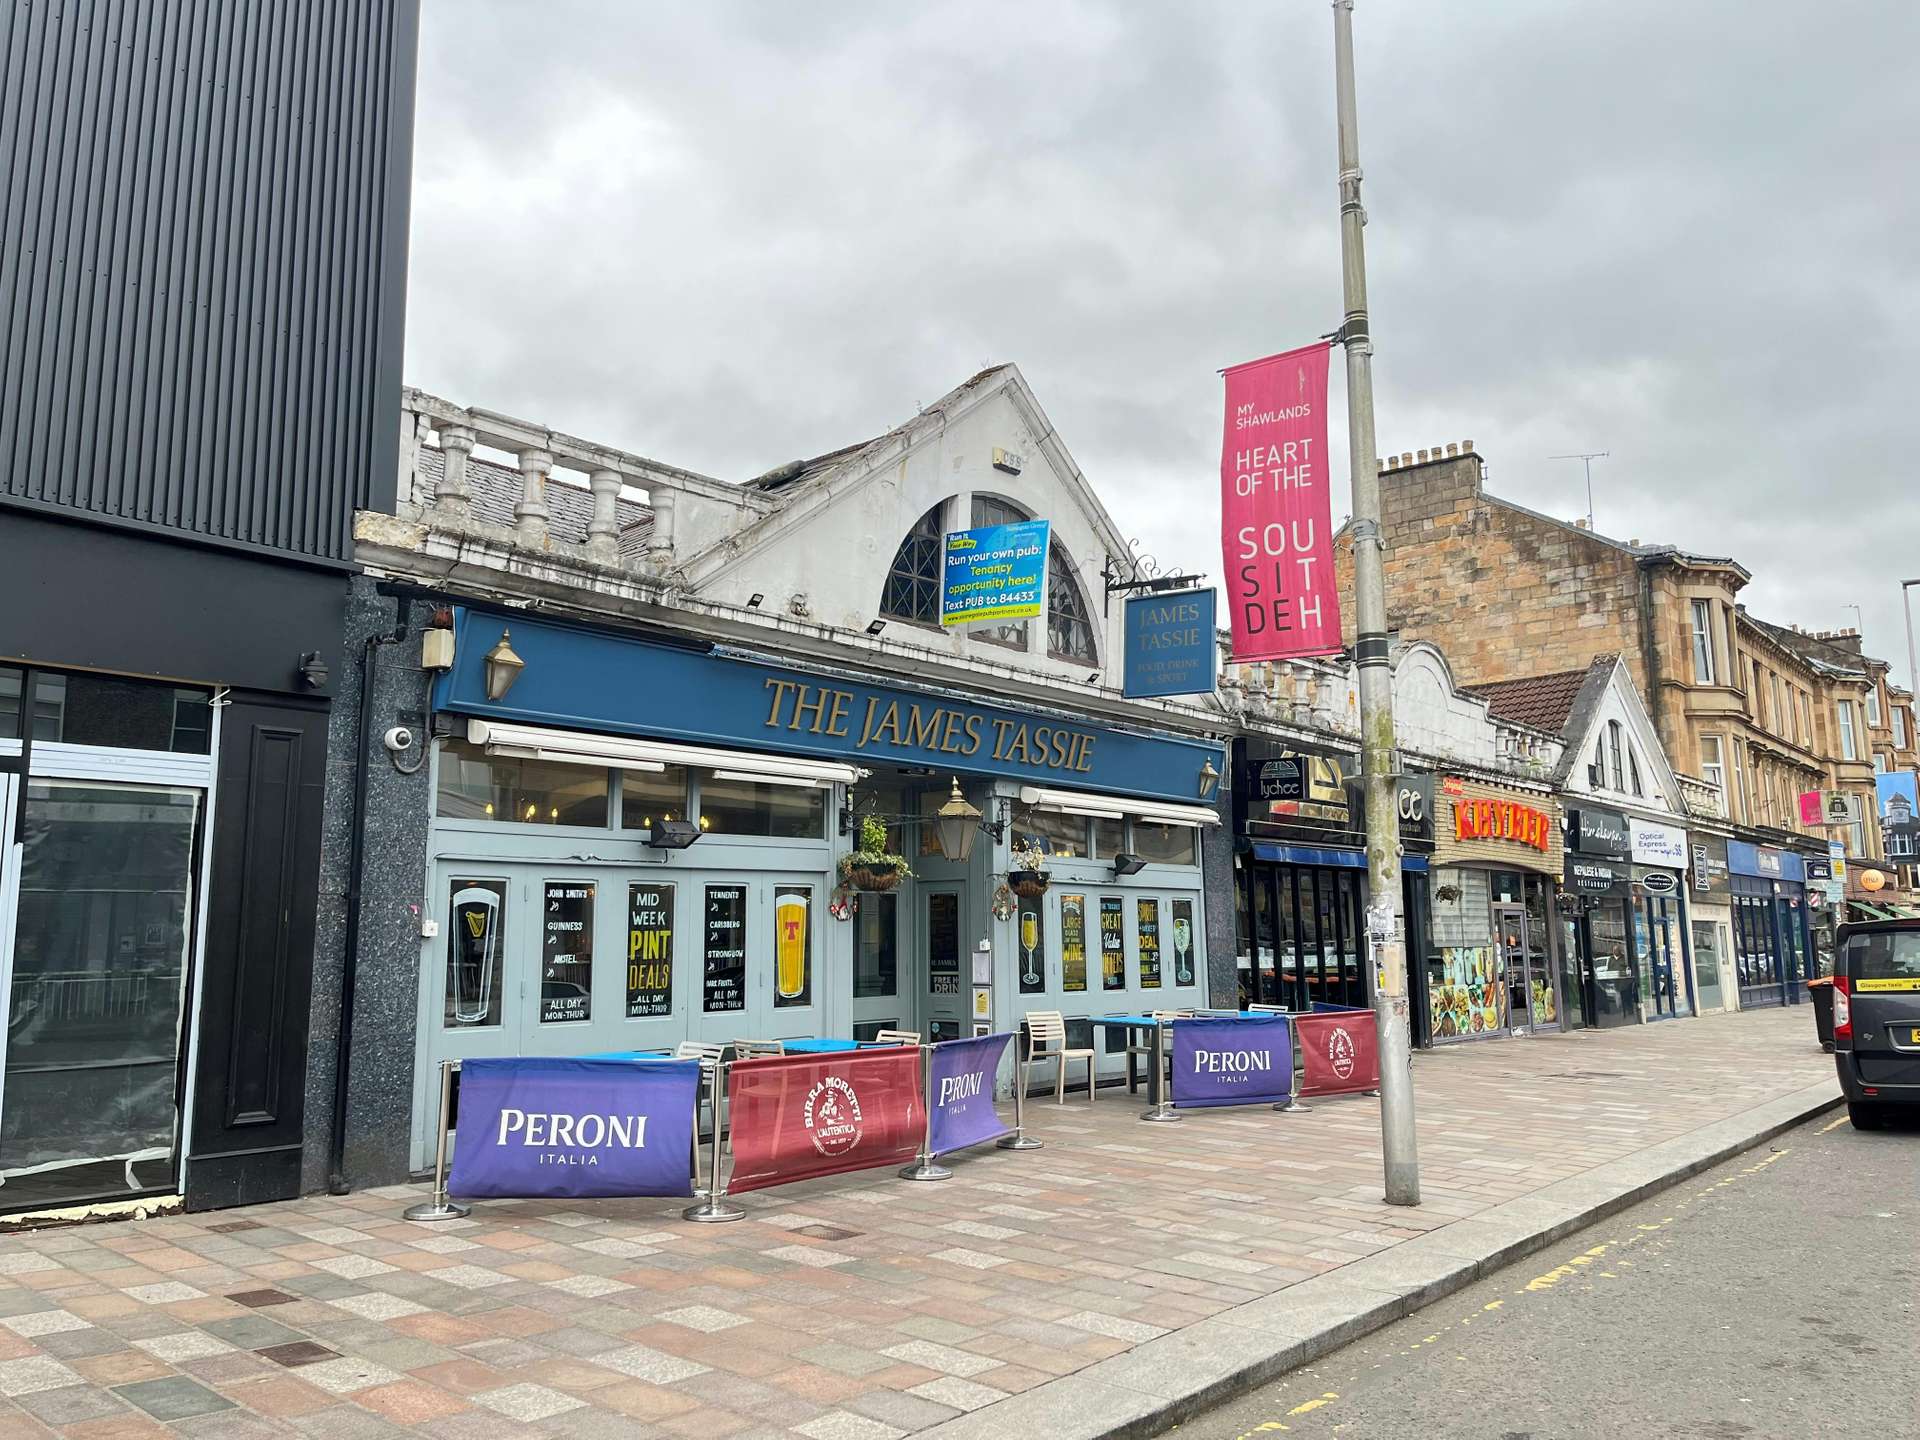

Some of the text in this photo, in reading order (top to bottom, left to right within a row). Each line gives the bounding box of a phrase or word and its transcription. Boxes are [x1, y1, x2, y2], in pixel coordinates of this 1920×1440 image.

[1236, 403, 1311, 430] SHAWLANDS
[1237, 402, 1255, 417] MY
[1237, 439, 1312, 471] HEART
[1236, 464, 1312, 496] OF THE
[1239, 518, 1314, 559] SOU
[948, 545, 1042, 566] Run your own pub:
[971, 564, 1012, 576] Tenancy
[949, 575, 1036, 595] opportunity here!
[945, 591, 1034, 611] Text PUB to 84433
[1140, 603, 1200, 628] JAMES
[1245, 595, 1322, 634] DEH
[1138, 628, 1200, 650] TASSIE
[765, 678, 1096, 773] THE JAMES TASSIE
[1261, 779, 1299, 799] lychee
[1640, 832, 1665, 841] Optical
[1638, 841, 1667, 849] Express
[636, 893, 659, 906] MID
[632, 911, 666, 925] WEEK
[709, 921, 740, 929] CARLSBERG
[1101, 913, 1121, 929] GREAT
[547, 922, 583, 931] GUINNESS
[785, 921, 800, 940] T
[630, 930, 672, 960] PINT
[1139, 935, 1157, 949] DEAL
[553, 954, 577, 964] AMSTEL
[708, 949, 744, 958] STRONGBOW
[1063, 943, 1083, 961] WINE
[629, 964, 669, 990] DEALS
[933, 976, 949, 984] FREE
[714, 990, 739, 1000] ALL DAY
[934, 983, 959, 993] DRIN
[551, 999, 582, 1009] ALL DAY
[652, 994, 665, 1003] DAY
[545, 1010, 584, 1020] MON-THUR
[1194, 1050, 1271, 1073] PERONI
[1217, 1075, 1248, 1083] ITALIA
[804, 1077, 862, 1128] BIRRA MORETTI
[496, 1109, 648, 1148] PERONI
[540, 1154, 598, 1165] ITALIA
